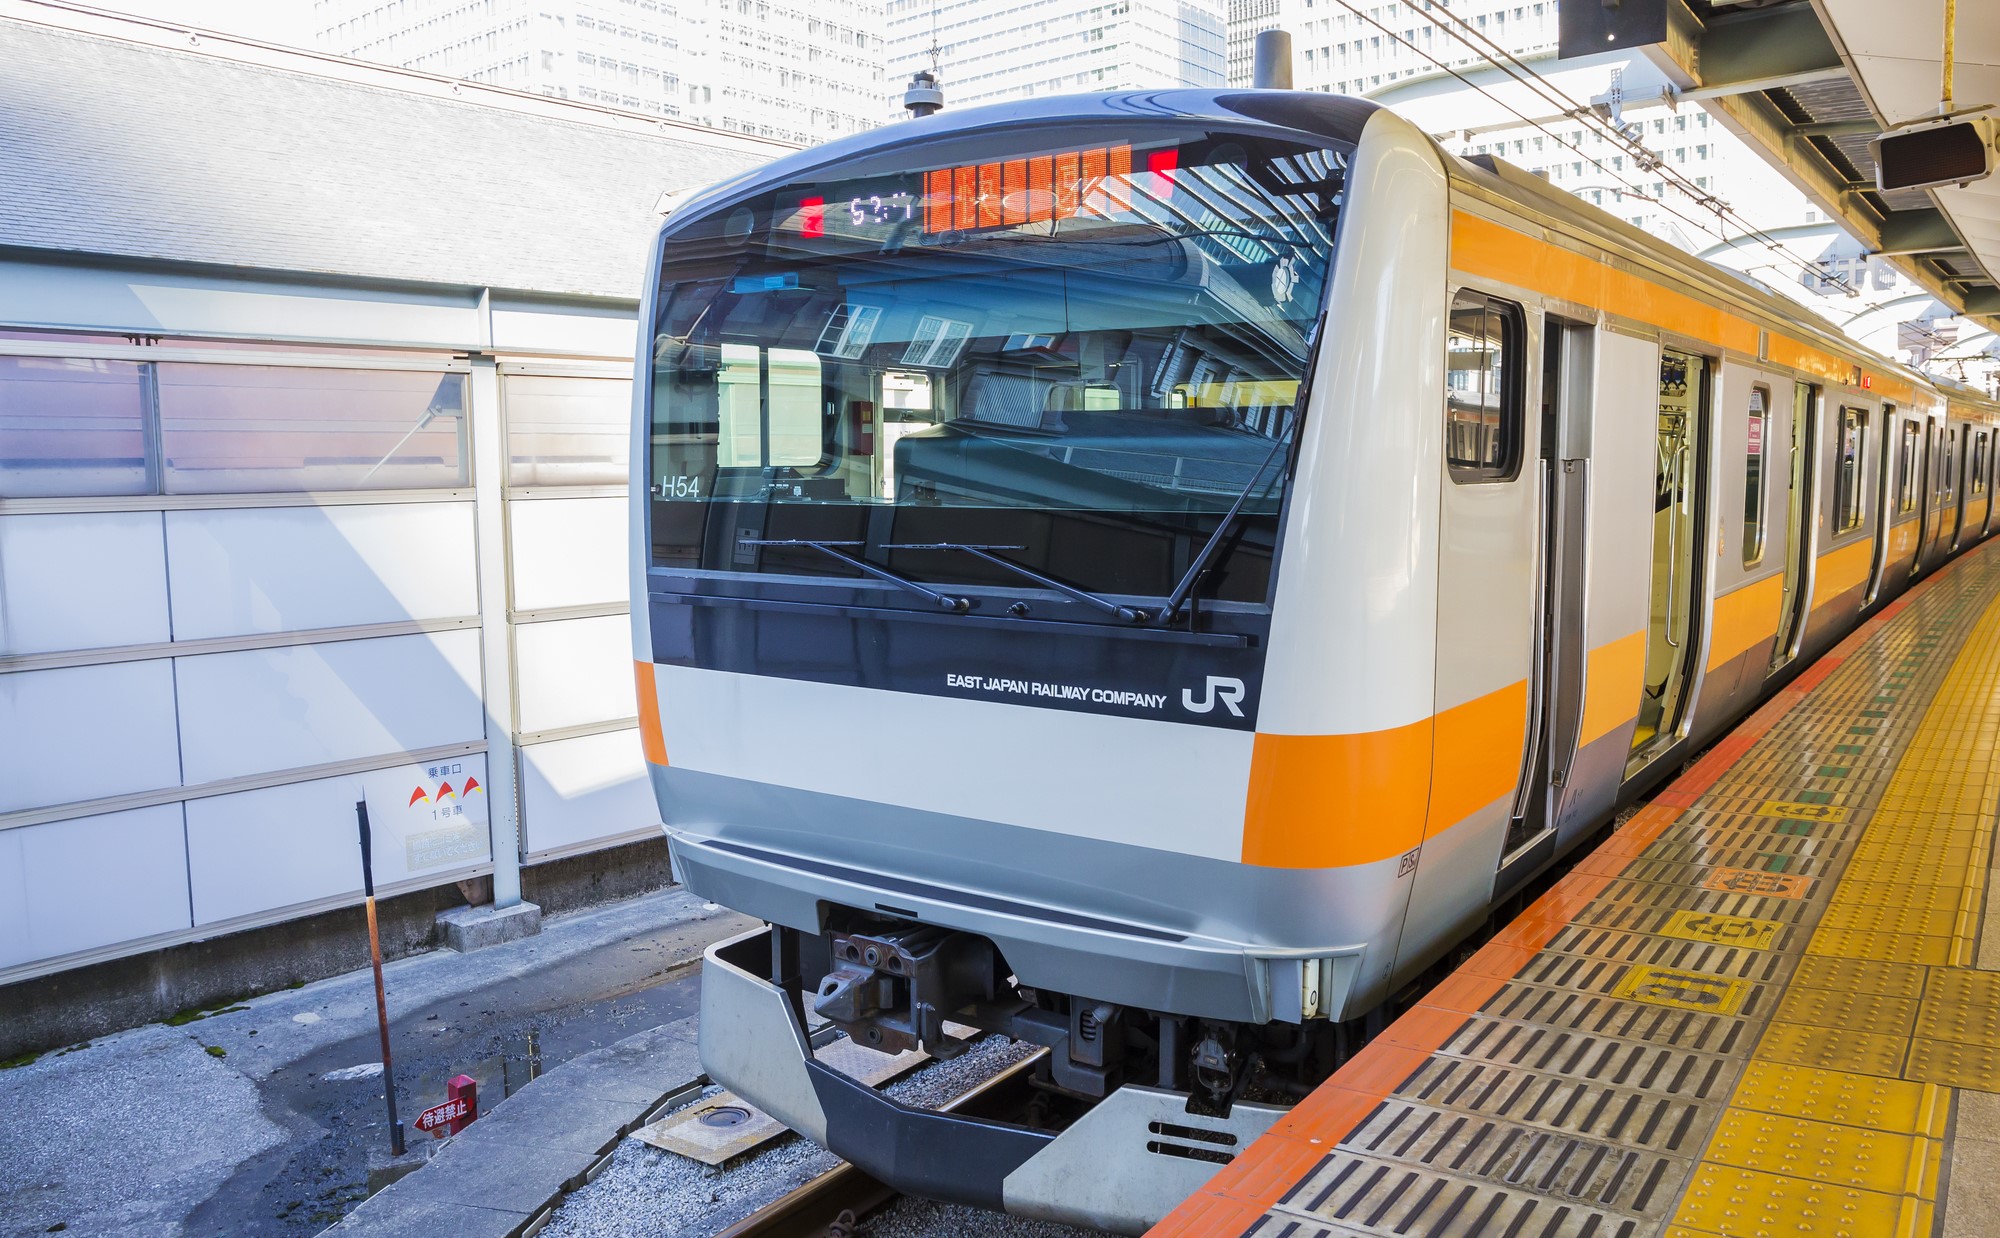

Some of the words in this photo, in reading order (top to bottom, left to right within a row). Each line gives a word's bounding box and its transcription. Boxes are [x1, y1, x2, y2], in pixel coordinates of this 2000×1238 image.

[661, 475, 700, 498] H54
[947, 674, 983, 690] EAST
[983, 678, 1028, 695] JAPAN
[1031, 682, 1091, 701] RAILWAY
[1092, 689, 1167, 709] COMPANY
[1181, 675, 1246, 718] JR
[428, 763, 462, 779] 乗車口
[431, 804, 463, 821] 1号車
[422, 1100, 467, 1128] 待避禁止
